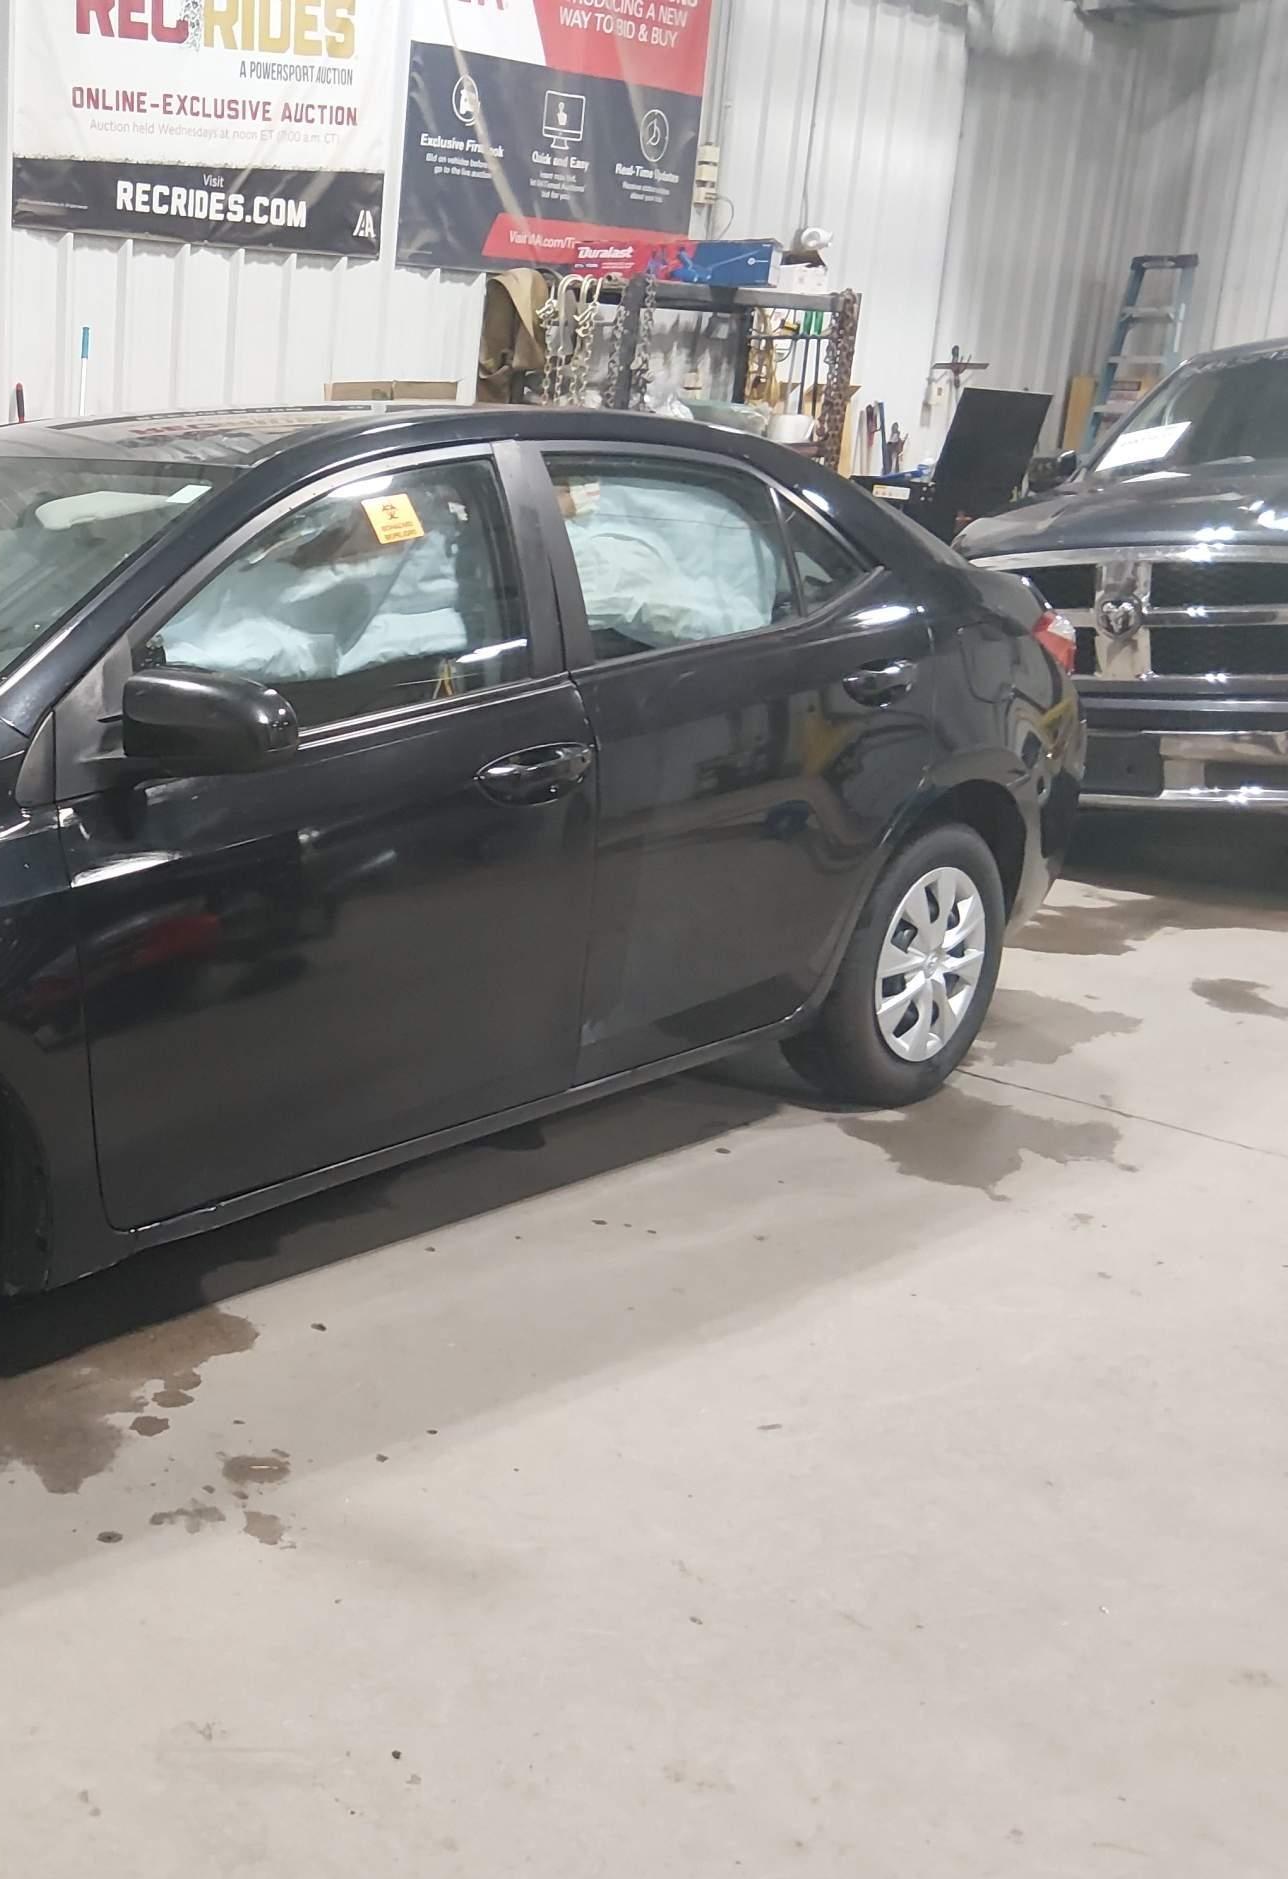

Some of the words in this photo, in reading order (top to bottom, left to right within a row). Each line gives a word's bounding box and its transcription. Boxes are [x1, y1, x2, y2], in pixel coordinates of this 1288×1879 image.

[559, 6, 592, 29] WAY
[594, 13, 613, 34] TO
[616, 18, 636, 39] BID
[638, 23, 648, 42] &
[651, 26, 678, 48] BUY
[646, 4, 655, 21] A
[658, 5, 688, 28] NEW
[204, 0, 356, 59] RIDES
[240, 60, 247, 79] A
[250, 61, 315, 83] POWERSPORT
[316, 66, 353, 86] AUCTION
[72, 86, 272, 122] ONLINE-EXCLUSIVE
[281, 102, 358, 126] AUCTION
[90, 119, 130, 133] Auction
[132, 121, 155, 135] held
[158, 123, 218, 139] Wednesdays
[420, 133, 465, 150] Exclusive
[531, 150, 552, 165] Quick
[569, 157, 591, 172] Easy
[203, 174, 225, 188] Visit
[116, 180, 307, 228] RECRIDES.COM
[578, 246, 635, 259] Duralast
